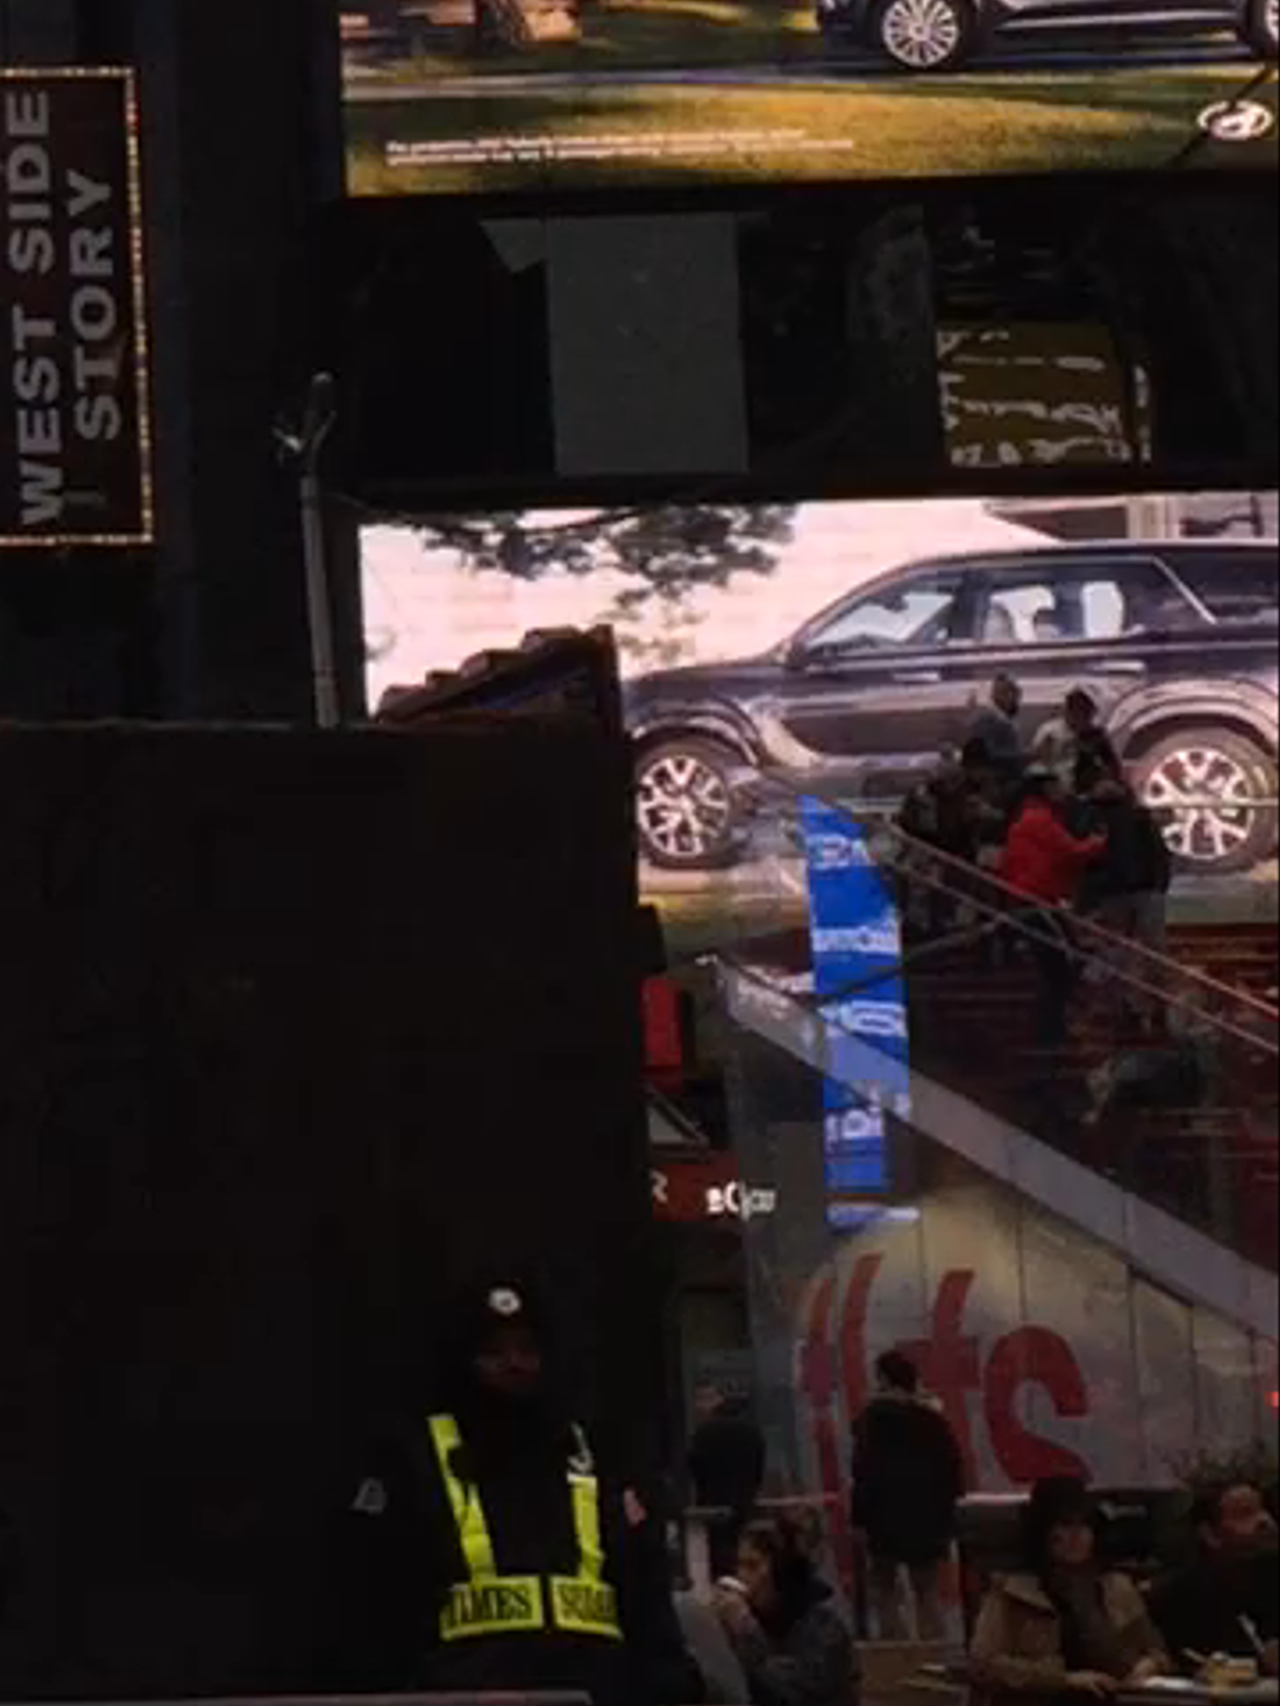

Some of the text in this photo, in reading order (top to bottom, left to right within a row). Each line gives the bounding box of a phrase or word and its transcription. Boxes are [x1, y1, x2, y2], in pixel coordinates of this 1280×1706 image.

[4, 89, 66, 525] WEST SIDE
[67, 170, 122, 442] STORY
